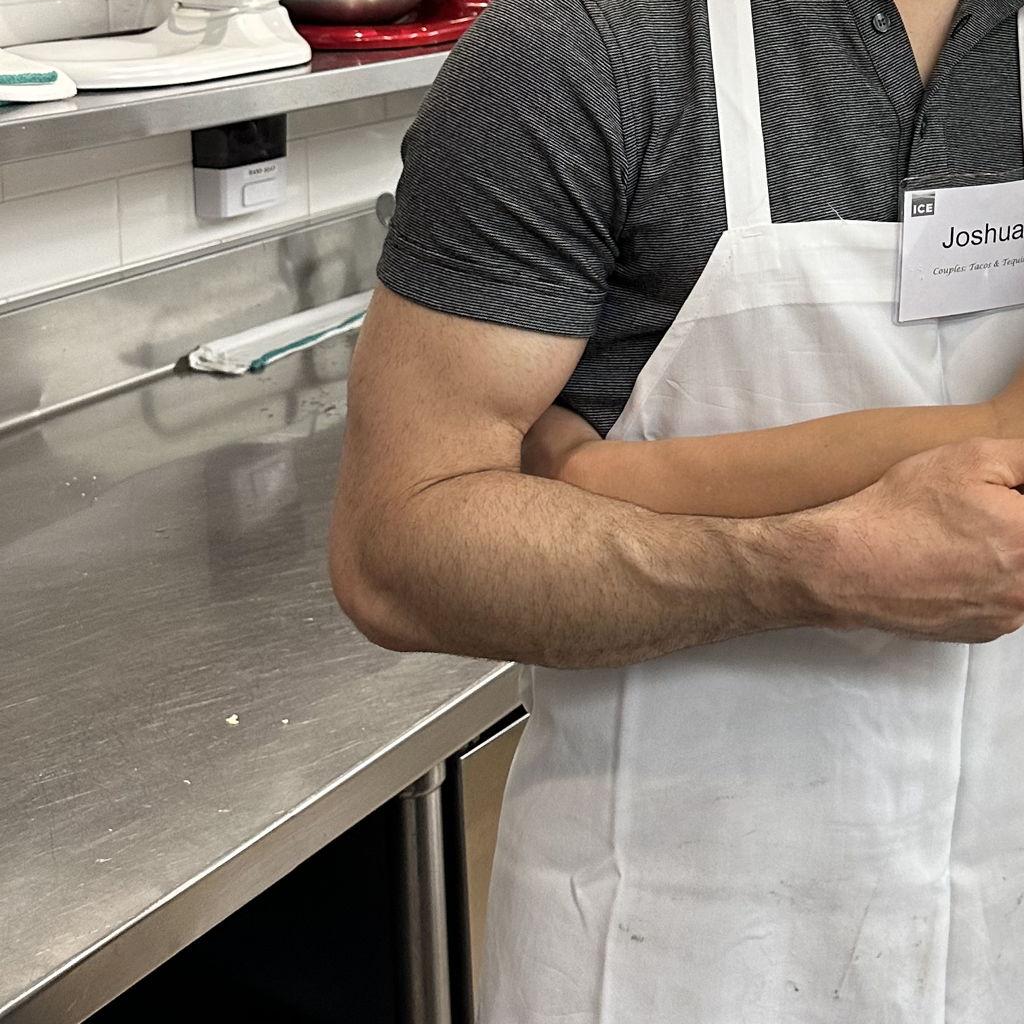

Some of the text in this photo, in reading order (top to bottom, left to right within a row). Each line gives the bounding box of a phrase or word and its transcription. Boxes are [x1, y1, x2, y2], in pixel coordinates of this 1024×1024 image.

[912, 203, 934, 215] ICE
[942, 223, 1024, 249] Joshua
[969, 262, 991, 271] Tacos
[993, 260, 1000, 268] &
